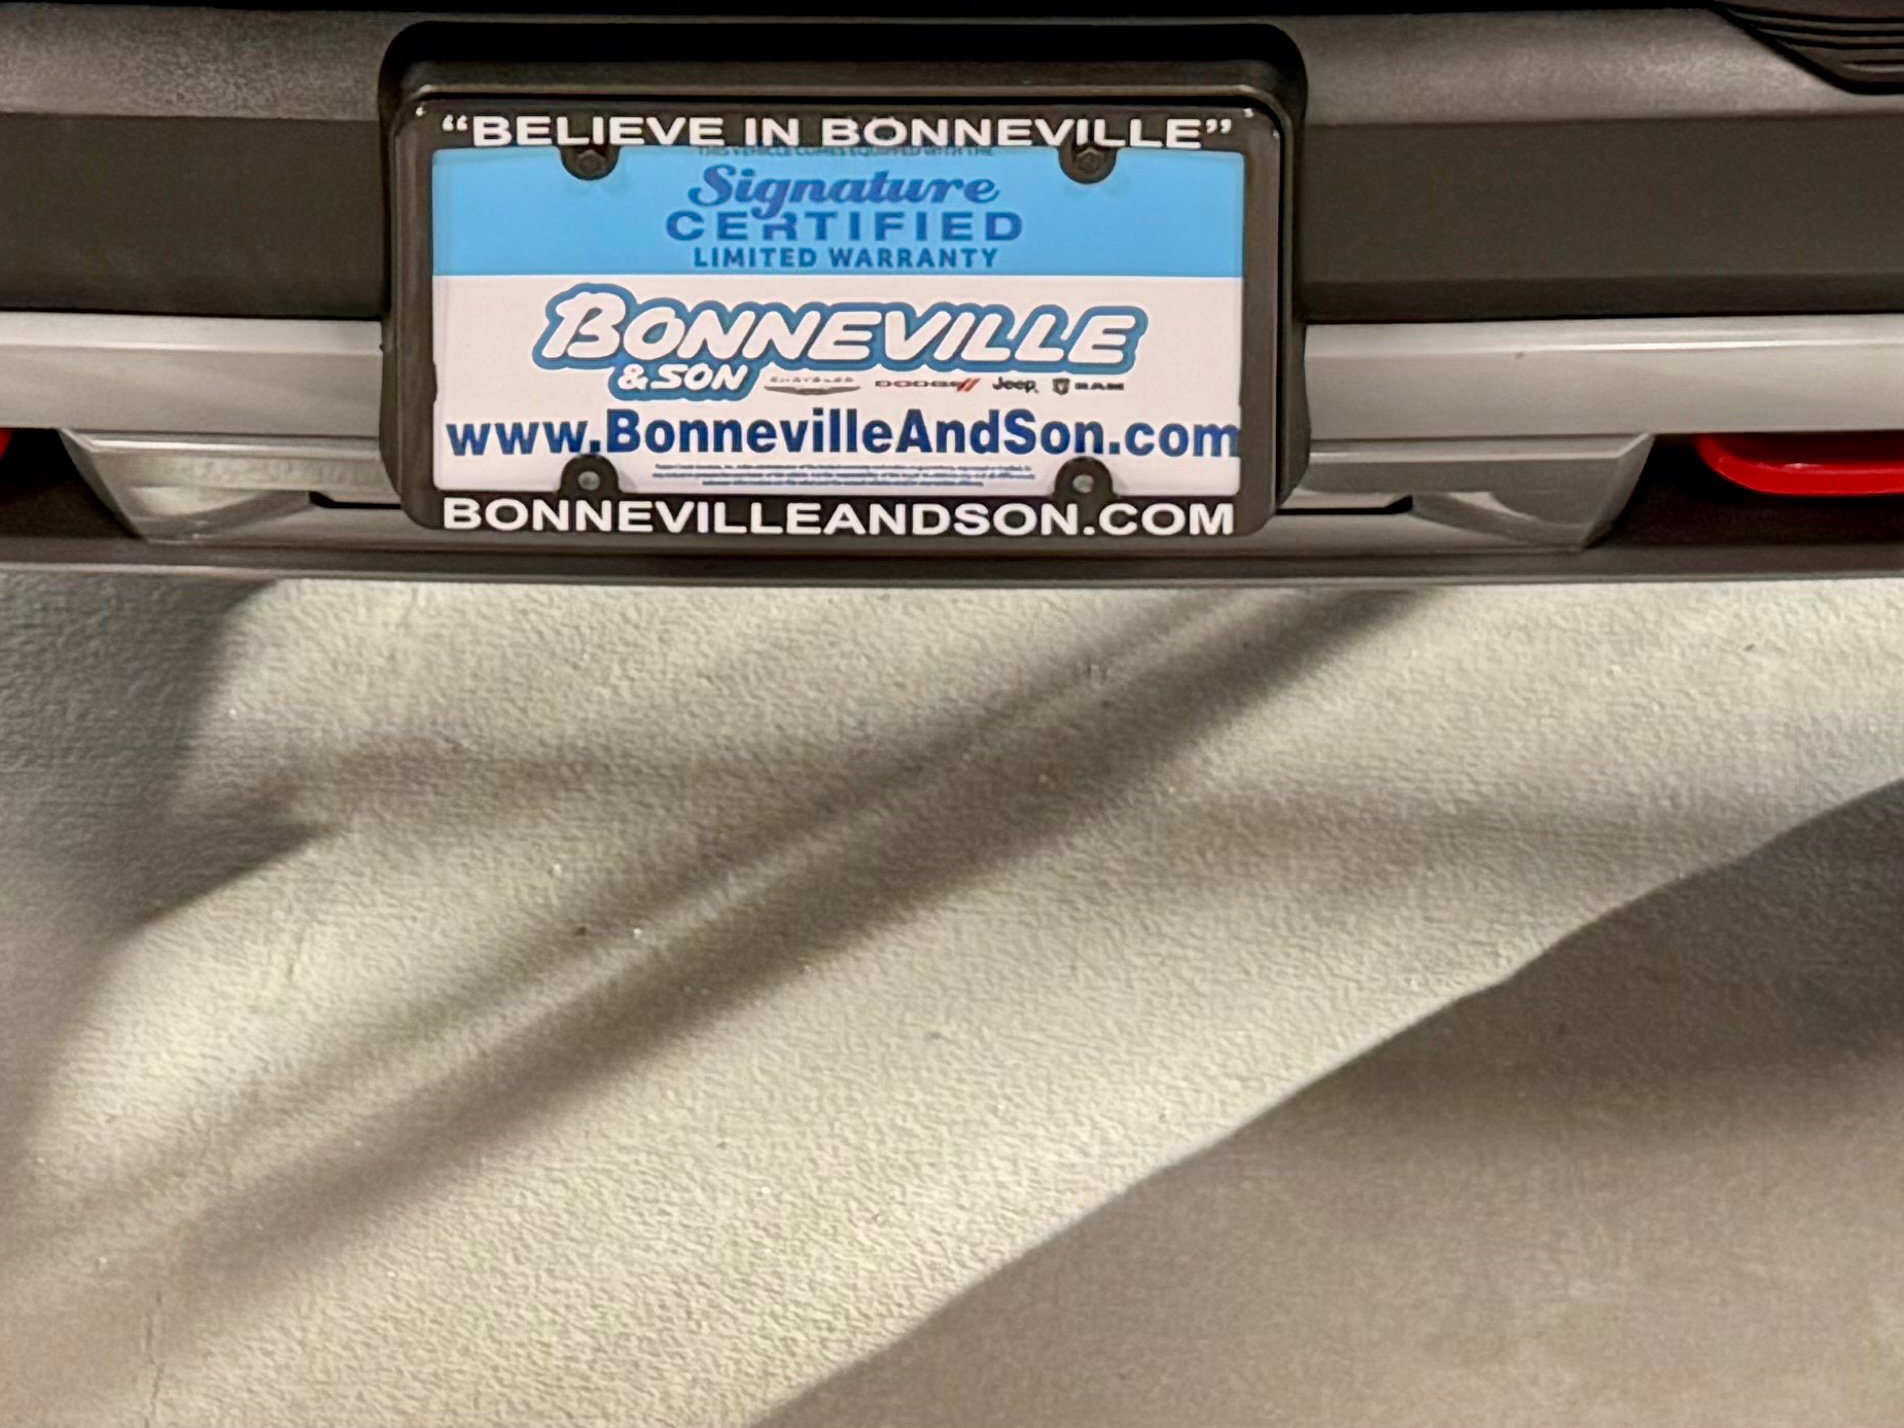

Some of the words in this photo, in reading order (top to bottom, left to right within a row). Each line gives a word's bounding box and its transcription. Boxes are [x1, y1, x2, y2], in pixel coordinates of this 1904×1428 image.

[745, 118, 800, 147] IN
[688, 164, 1001, 221] Signature
[665, 211, 1023, 242] CERTIFIED
[694, 247, 817, 269] LIMITED
[829, 247, 998, 269] WARRANTY
[992, 375, 1036, 394] Jeep
[445, 407, 1239, 458] www.BonnevilleAndSon.com
[442, 496, 1234, 537] BONNEVILLEANDSON.COM
